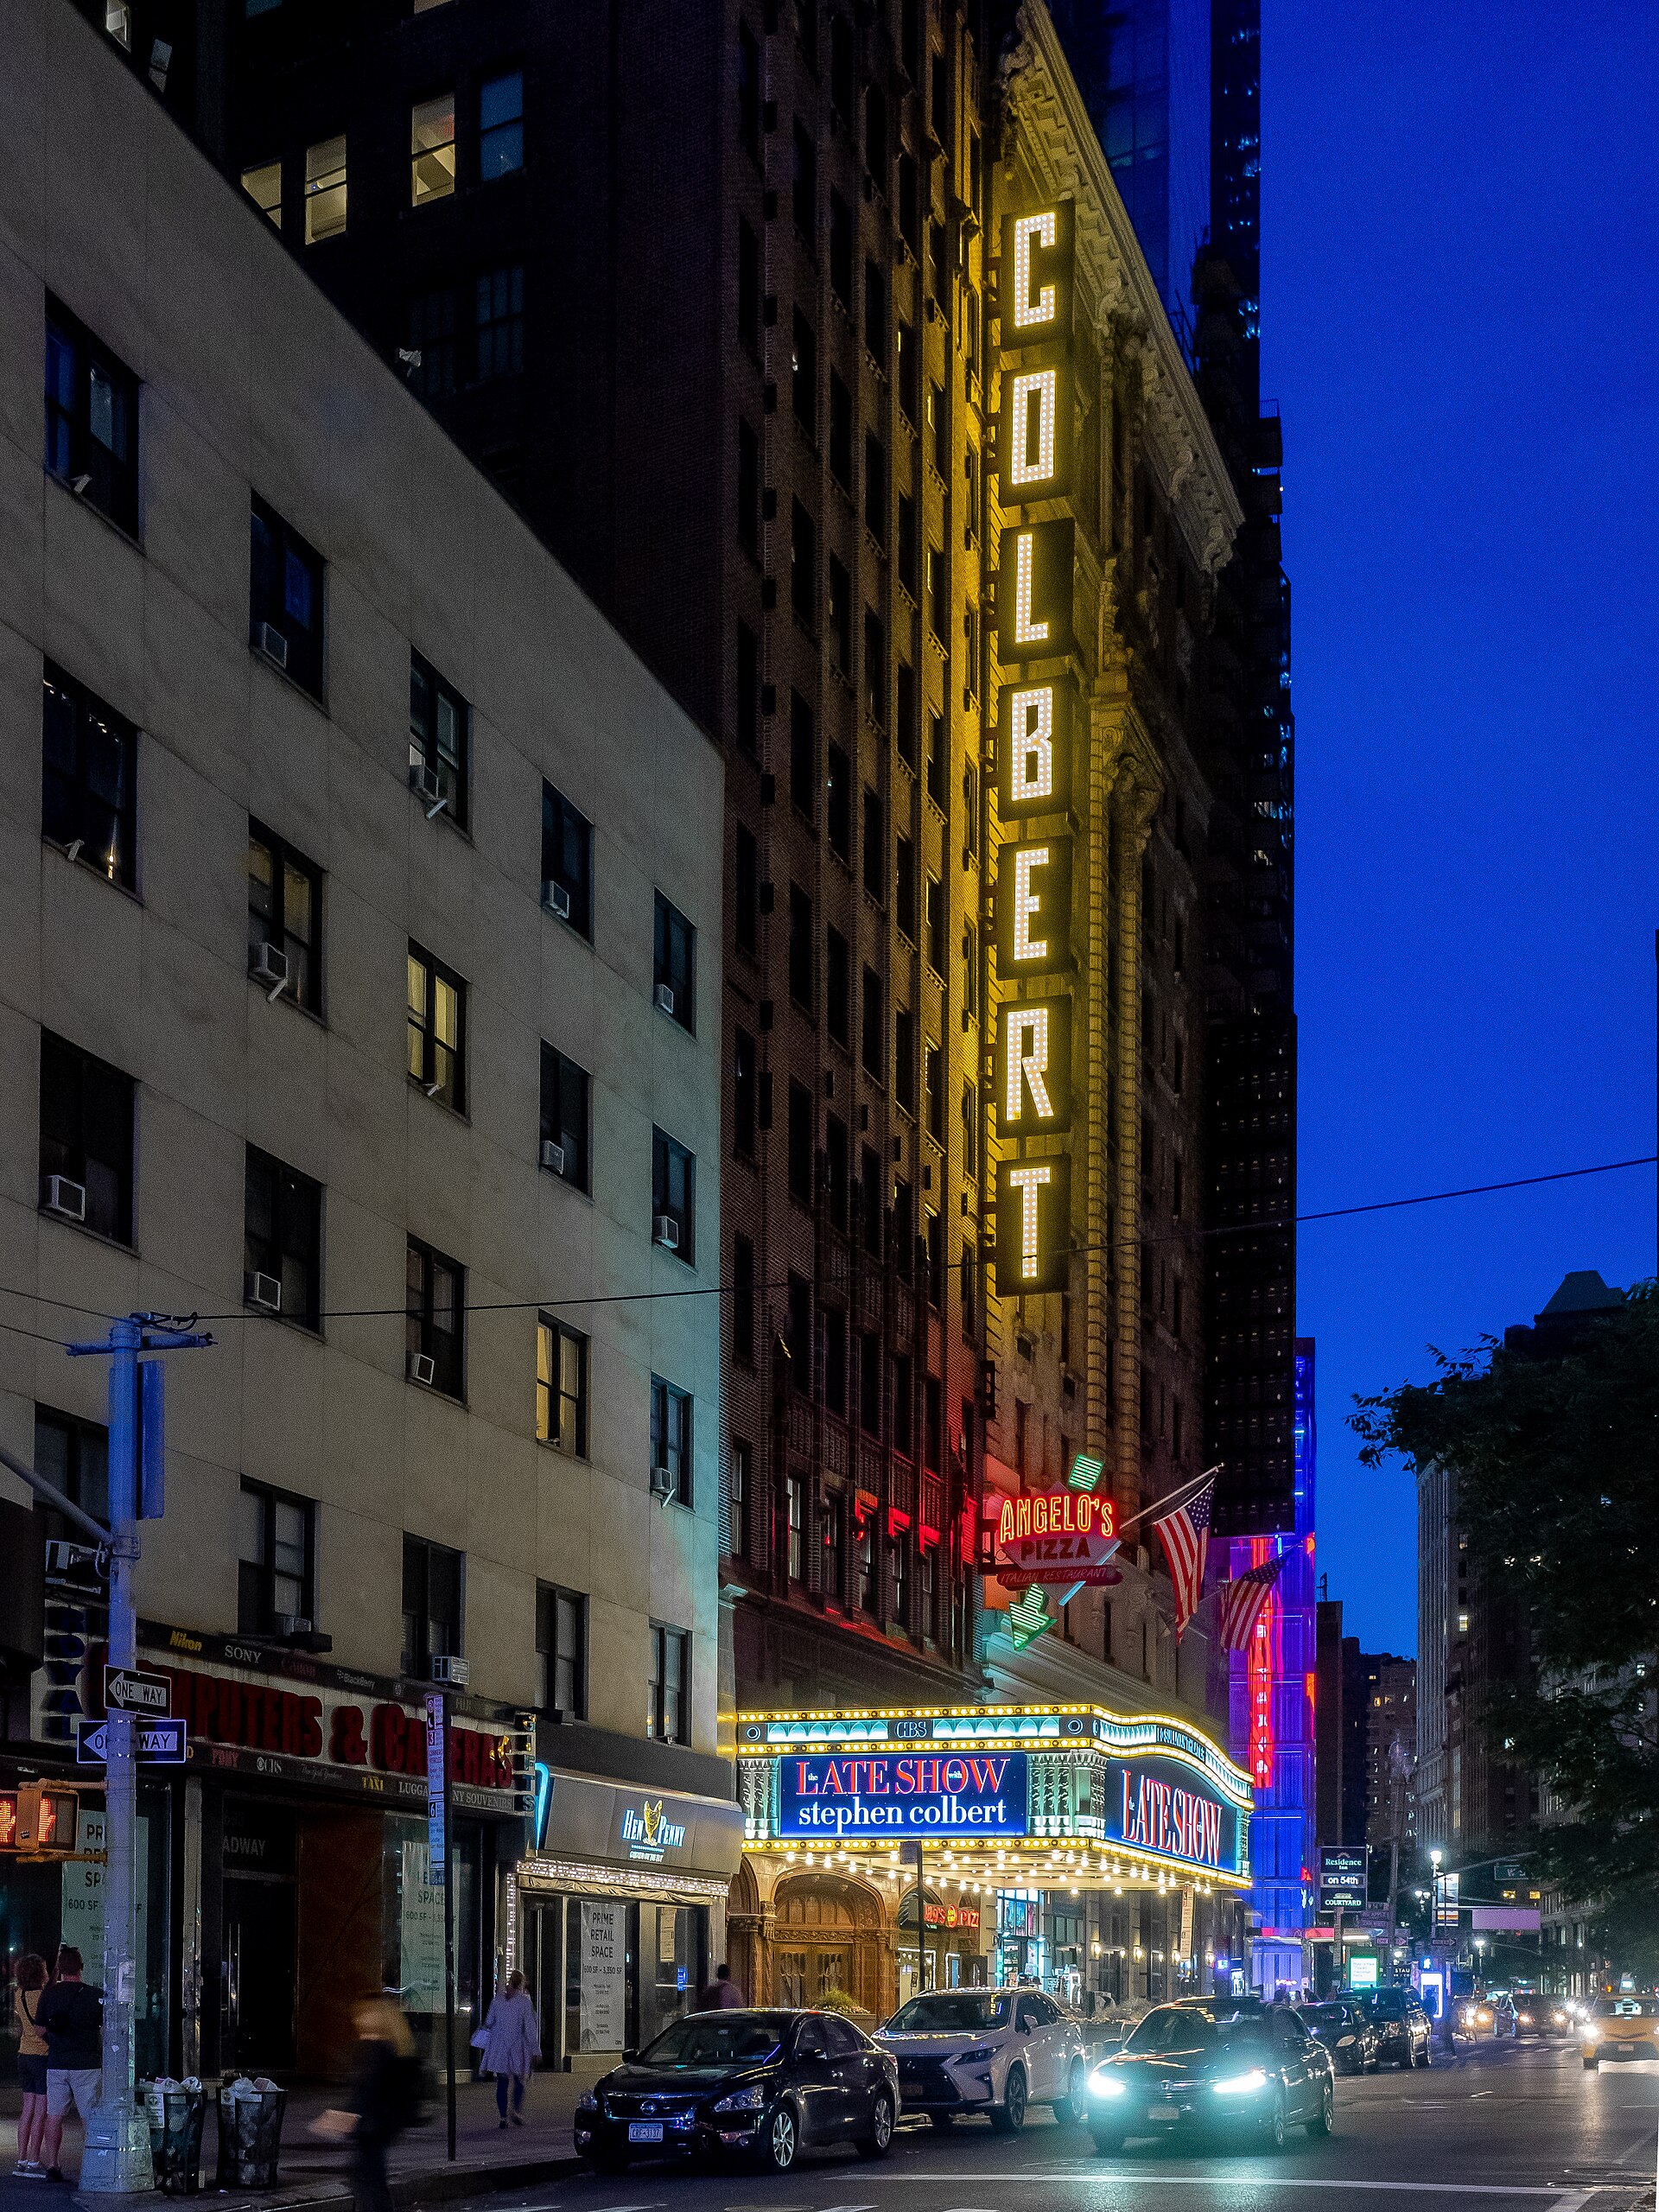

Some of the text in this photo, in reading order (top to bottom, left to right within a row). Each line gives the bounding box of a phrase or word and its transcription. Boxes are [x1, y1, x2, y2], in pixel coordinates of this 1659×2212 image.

[1006, 211, 1057, 1281] COLBERT
[1000, 1494, 1114, 1544] ANGELO'S
[1020, 1537, 1091, 1561] PIZZA
[1001, 1567, 1107, 1584] ITALIAN RESTAURANT
[169, 1630, 203, 1651] Nikon
[225, 1644, 261, 1663] SONY
[116, 1681, 163, 1704] ONE WAY
[894, 1720, 928, 1738] CBS
[138, 1733, 171, 1750] WAY
[372, 1703, 512, 1789] CAERAS
[795, 1759, 889, 1796] LATE
[807, 1770, 818, 1781] the
[894, 1758, 1011, 1795] SHOW
[362, 1775, 385, 1792] TAXI
[399, 1780, 428, 1796] LUGGA
[453, 1789, 466, 1802] NY
[467, 1790, 512, 1808] SOUVENIRS
[798, 1795, 1007, 1835] stephen colbert
[1122, 1769, 1172, 1852] LATE
[1172, 1787, 1224, 1866] SHOW
[622, 1808, 687, 1847] HEN PENNY
[1325, 1858, 1363, 1866] Residence
[1327, 1875, 1359, 1885] on 54th
[592, 1911, 614, 1925] PRIME
[589, 1928, 615, 1942] RETAIL
[590, 1945, 614, 1959] SPACE
